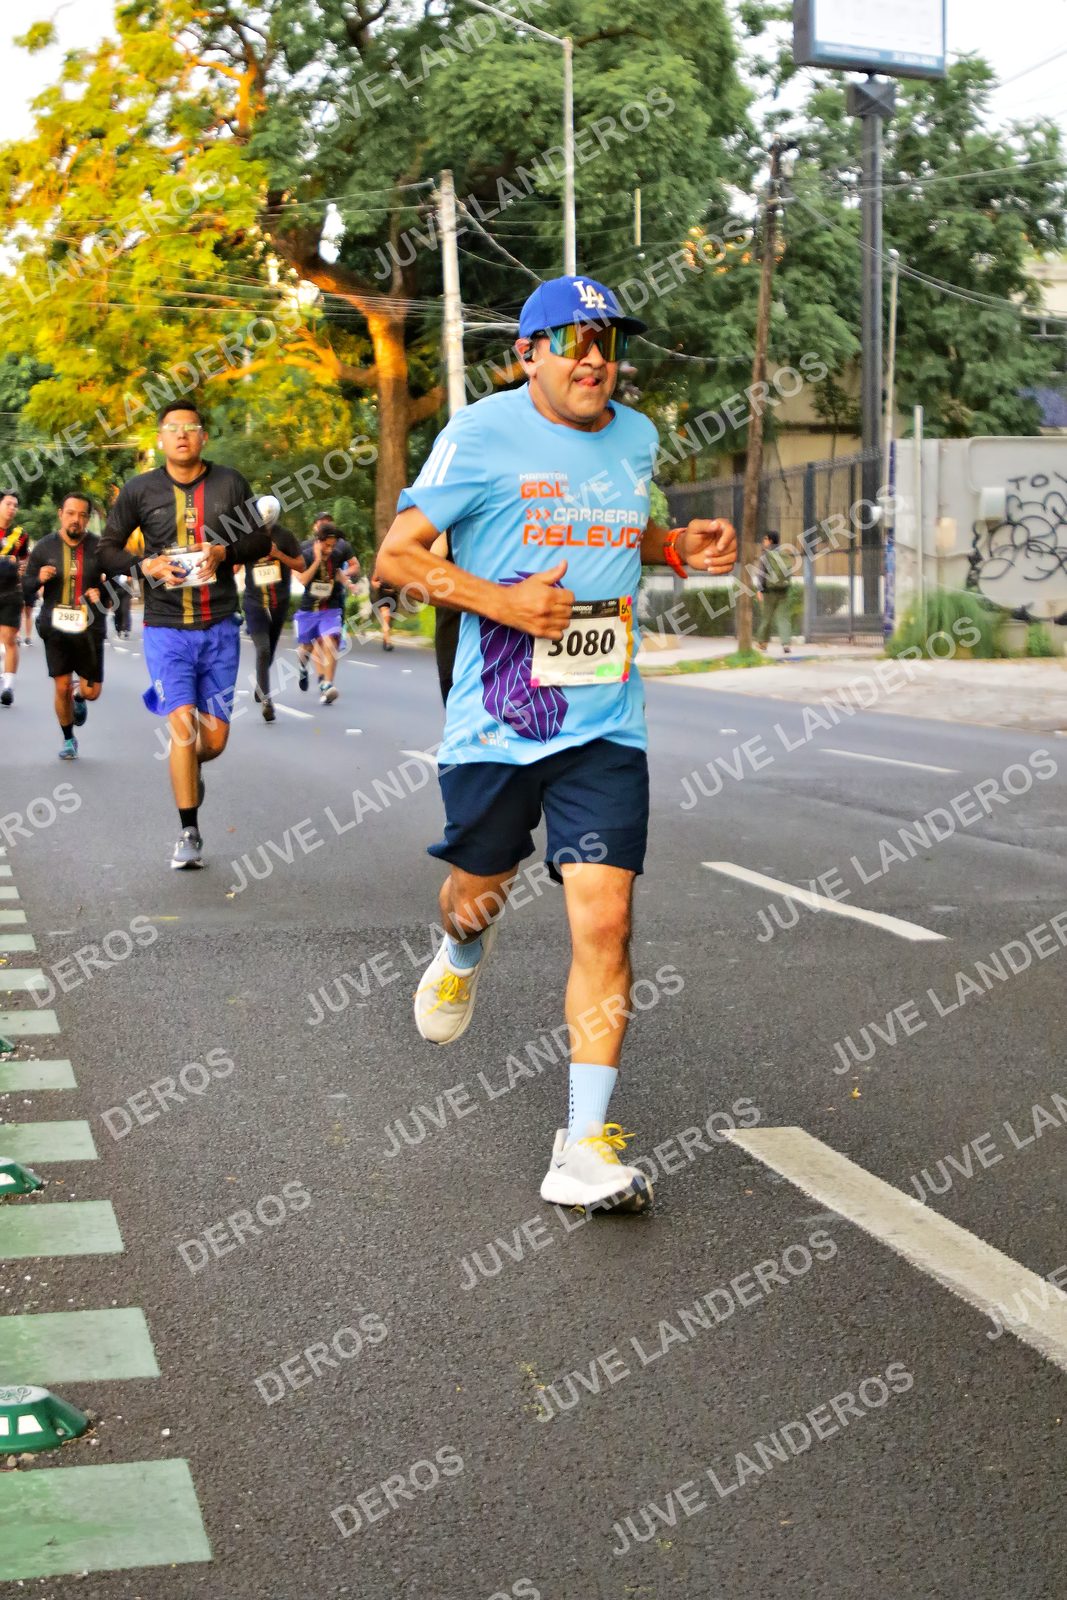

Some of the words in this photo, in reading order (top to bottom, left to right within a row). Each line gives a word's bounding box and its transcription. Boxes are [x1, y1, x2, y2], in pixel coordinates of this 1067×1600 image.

[573, 281, 607, 309] LA
[521, 480, 566, 499] GDL
[553, 507, 638, 524] CARRERA
[58, 611, 80, 622] 2987
[548, 628, 615, 657] 3080
